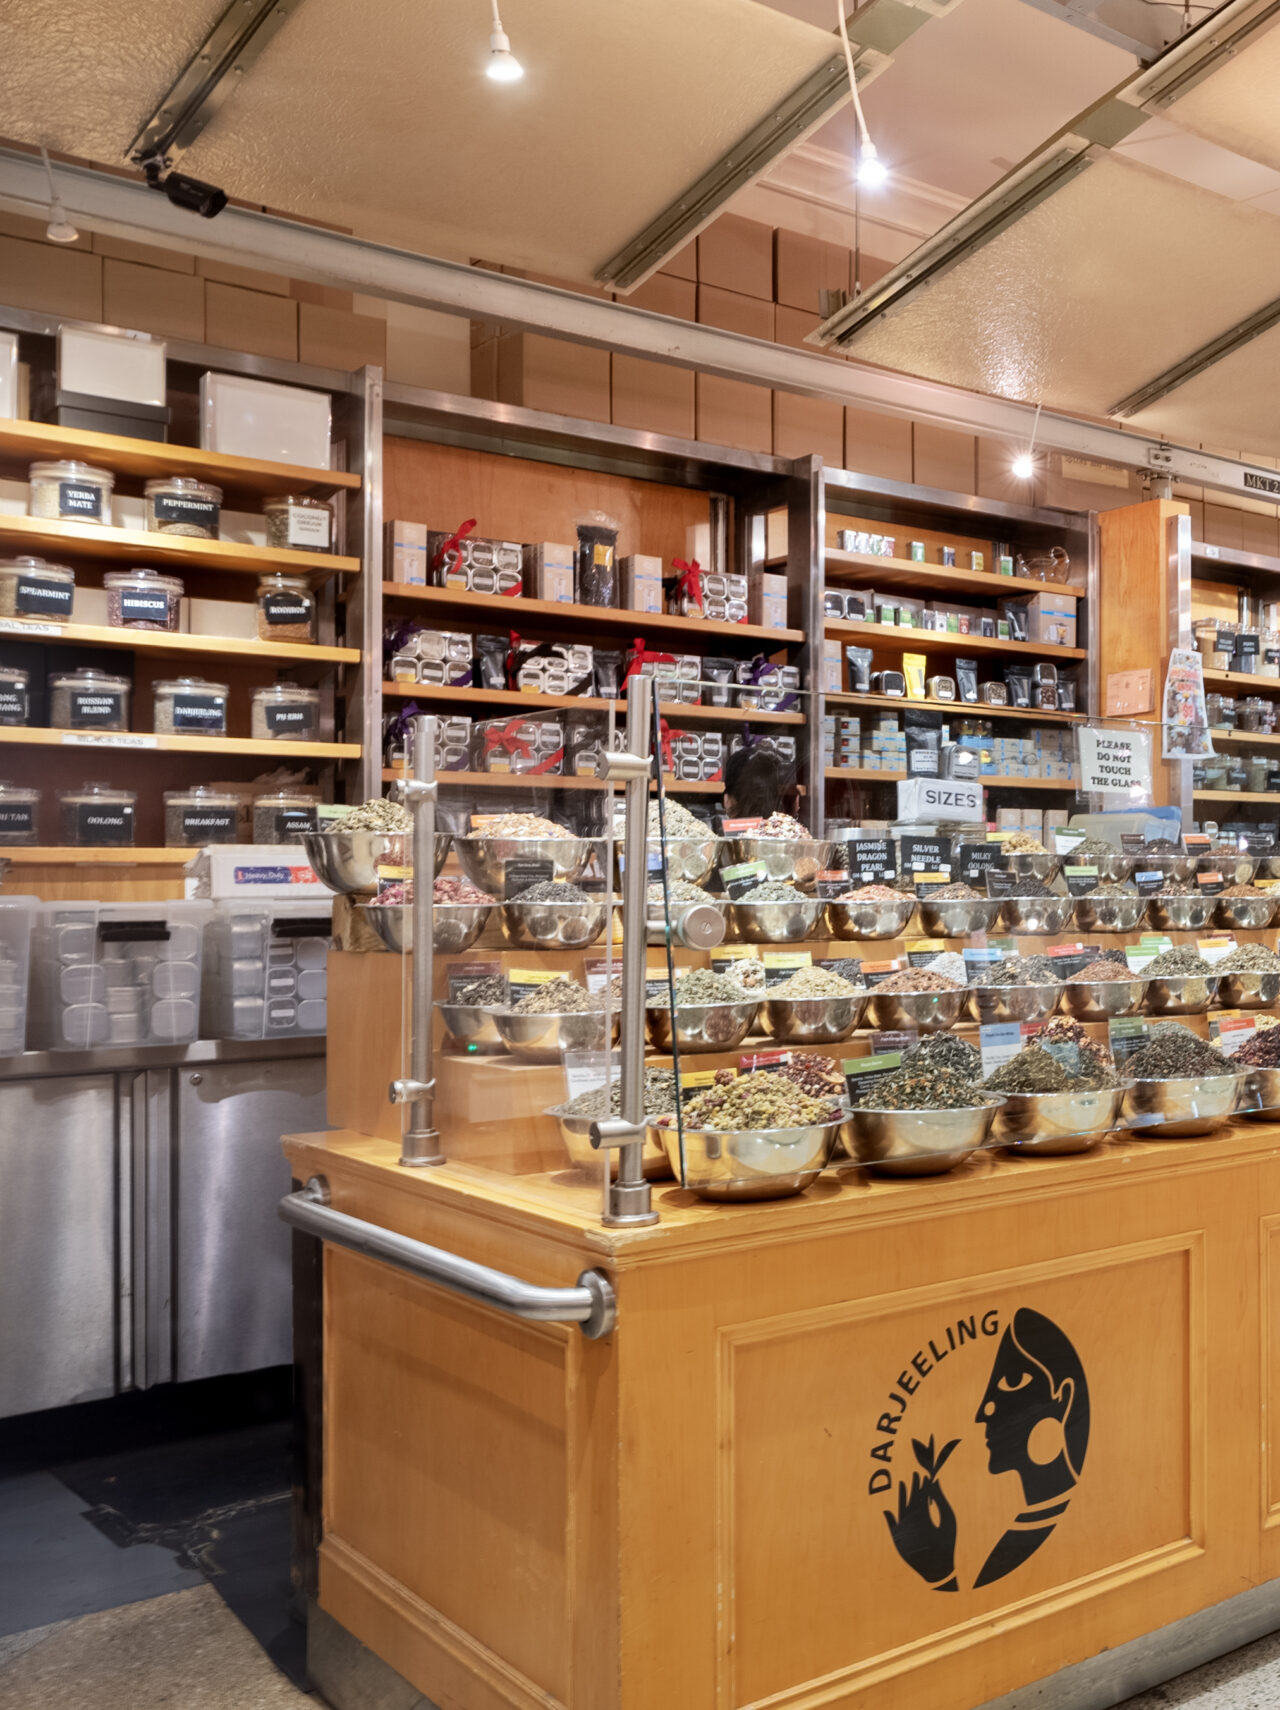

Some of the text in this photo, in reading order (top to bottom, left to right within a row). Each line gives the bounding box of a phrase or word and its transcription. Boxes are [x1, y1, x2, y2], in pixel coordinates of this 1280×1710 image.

[1245, 473, 1272, 491] MKT
[66, 489, 96, 501] YERBA
[68, 500, 93, 510] MATE
[163, 498, 214, 512] PEPPERMINT
[19, 585, 71, 600] SPEARMINT
[123, 598, 165, 609] HIBISCUS
[1096, 739, 1132, 751] PLEASE
[1097, 752, 1132, 763] DO NOT
[1099, 765, 1131, 776] TOUCH
[1091, 776, 1110, 786] THE
[925, 789, 977, 809] SIZES
[856, 841, 888, 852] JASMINE
[912, 844, 940, 854] SILVER
[856, 852, 888, 861] DRAGON
[911, 854, 941, 864] NEEDLE
[971, 852, 992, 860] MILKY
[861, 863, 885, 872] PEARL
[868, 1309, 1000, 1496] DARJEELING
